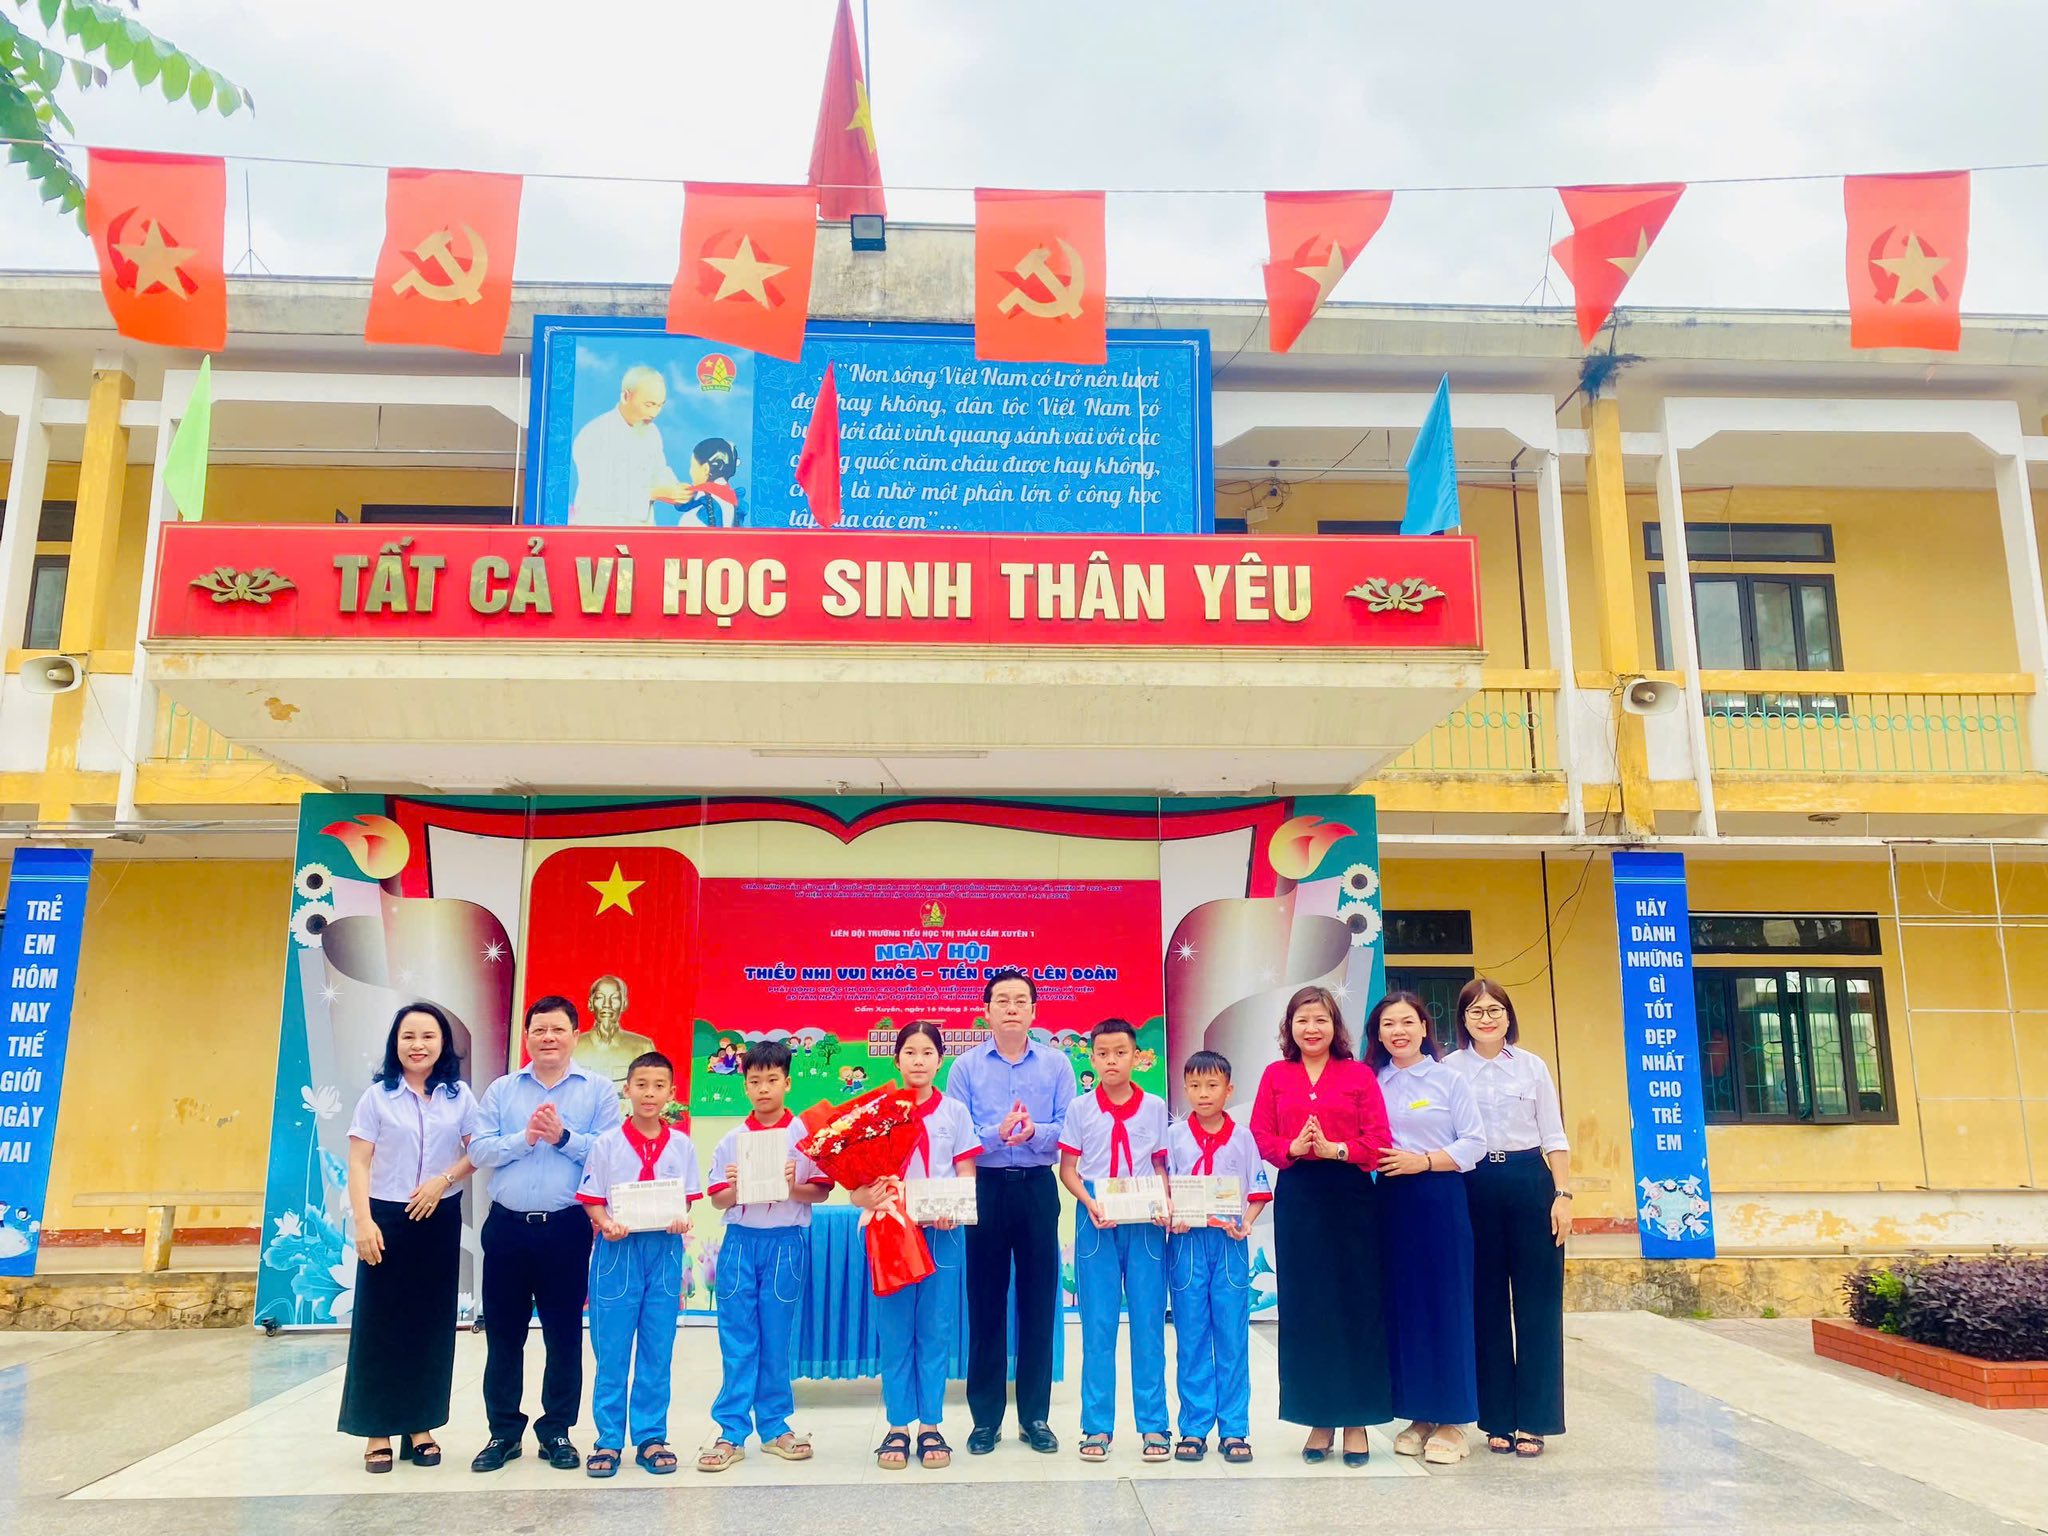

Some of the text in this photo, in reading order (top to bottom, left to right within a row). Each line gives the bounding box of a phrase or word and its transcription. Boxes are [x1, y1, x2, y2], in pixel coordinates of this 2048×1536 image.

[891, 365, 938, 390] sông
[940, 366, 979, 388] Việt
[981, 366, 1031, 387] Nam
[1031, 368, 1055, 387] có
[1055, 369, 1084, 388] trở
[1084, 370, 1119, 388] nên
[1121, 371, 1160, 389] tươi
[791, 392, 1162, 419] đẹ hay không, dân tộc Việt Nam có
[840, 421, 1161, 450] tới đài vinh quang sánh vai với các
[854, 448, 901, 475] quốc
[902, 452, 949, 472] năm
[951, 453, 1000, 474] châu
[1002, 455, 1052, 477] được
[1053, 456, 1093, 480] hay
[1094, 456, 1161, 481] không,
[850, 480, 872, 500] là
[876, 481, 918, 500] nhờ
[920, 482, 959, 505] một
[963, 481, 1014, 507] phần
[1020, 483, 1052, 503] lớn
[1058, 483, 1072, 503] ở
[1076, 484, 1124, 509] công
[1127, 486, 1162, 507] học
[862, 508, 898, 529] các
[332, 536, 1313, 627] TẤT CẢ VÌ HỌC SINH THÂN YÊU
[27, 894, 63, 921] TRẺ
[1636, 898, 1667, 917] HÃY
[1631, 923, 1676, 942] DÀNH
[23, 934, 56, 955] EM
[874, 940, 990, 963] NGÀY HỘI
[1627, 949, 1684, 968] NHỮNG
[11, 963, 59, 988] HÔM
[744, 962, 1118, 981] THIẾU NHI VUI KHỎE TIẾN LÊN ĐOÀN
[1649, 974, 1666, 993] GÌ
[10, 1002, 51, 1023] NAY
[1644, 997, 1673, 1019] TỐT
[8, 1030, 48, 1058] THẾ
[1645, 1028, 1677, 1048] ĐẸP
[1642, 1049, 1685, 1071] NHẤT
[0, 1067, 42, 1093] GIỚI
[1649, 1080, 1682, 1098] CHO
[1652, 1102, 1683, 1124] TRẺ
[1656, 1134, 1683, 1151] EM
